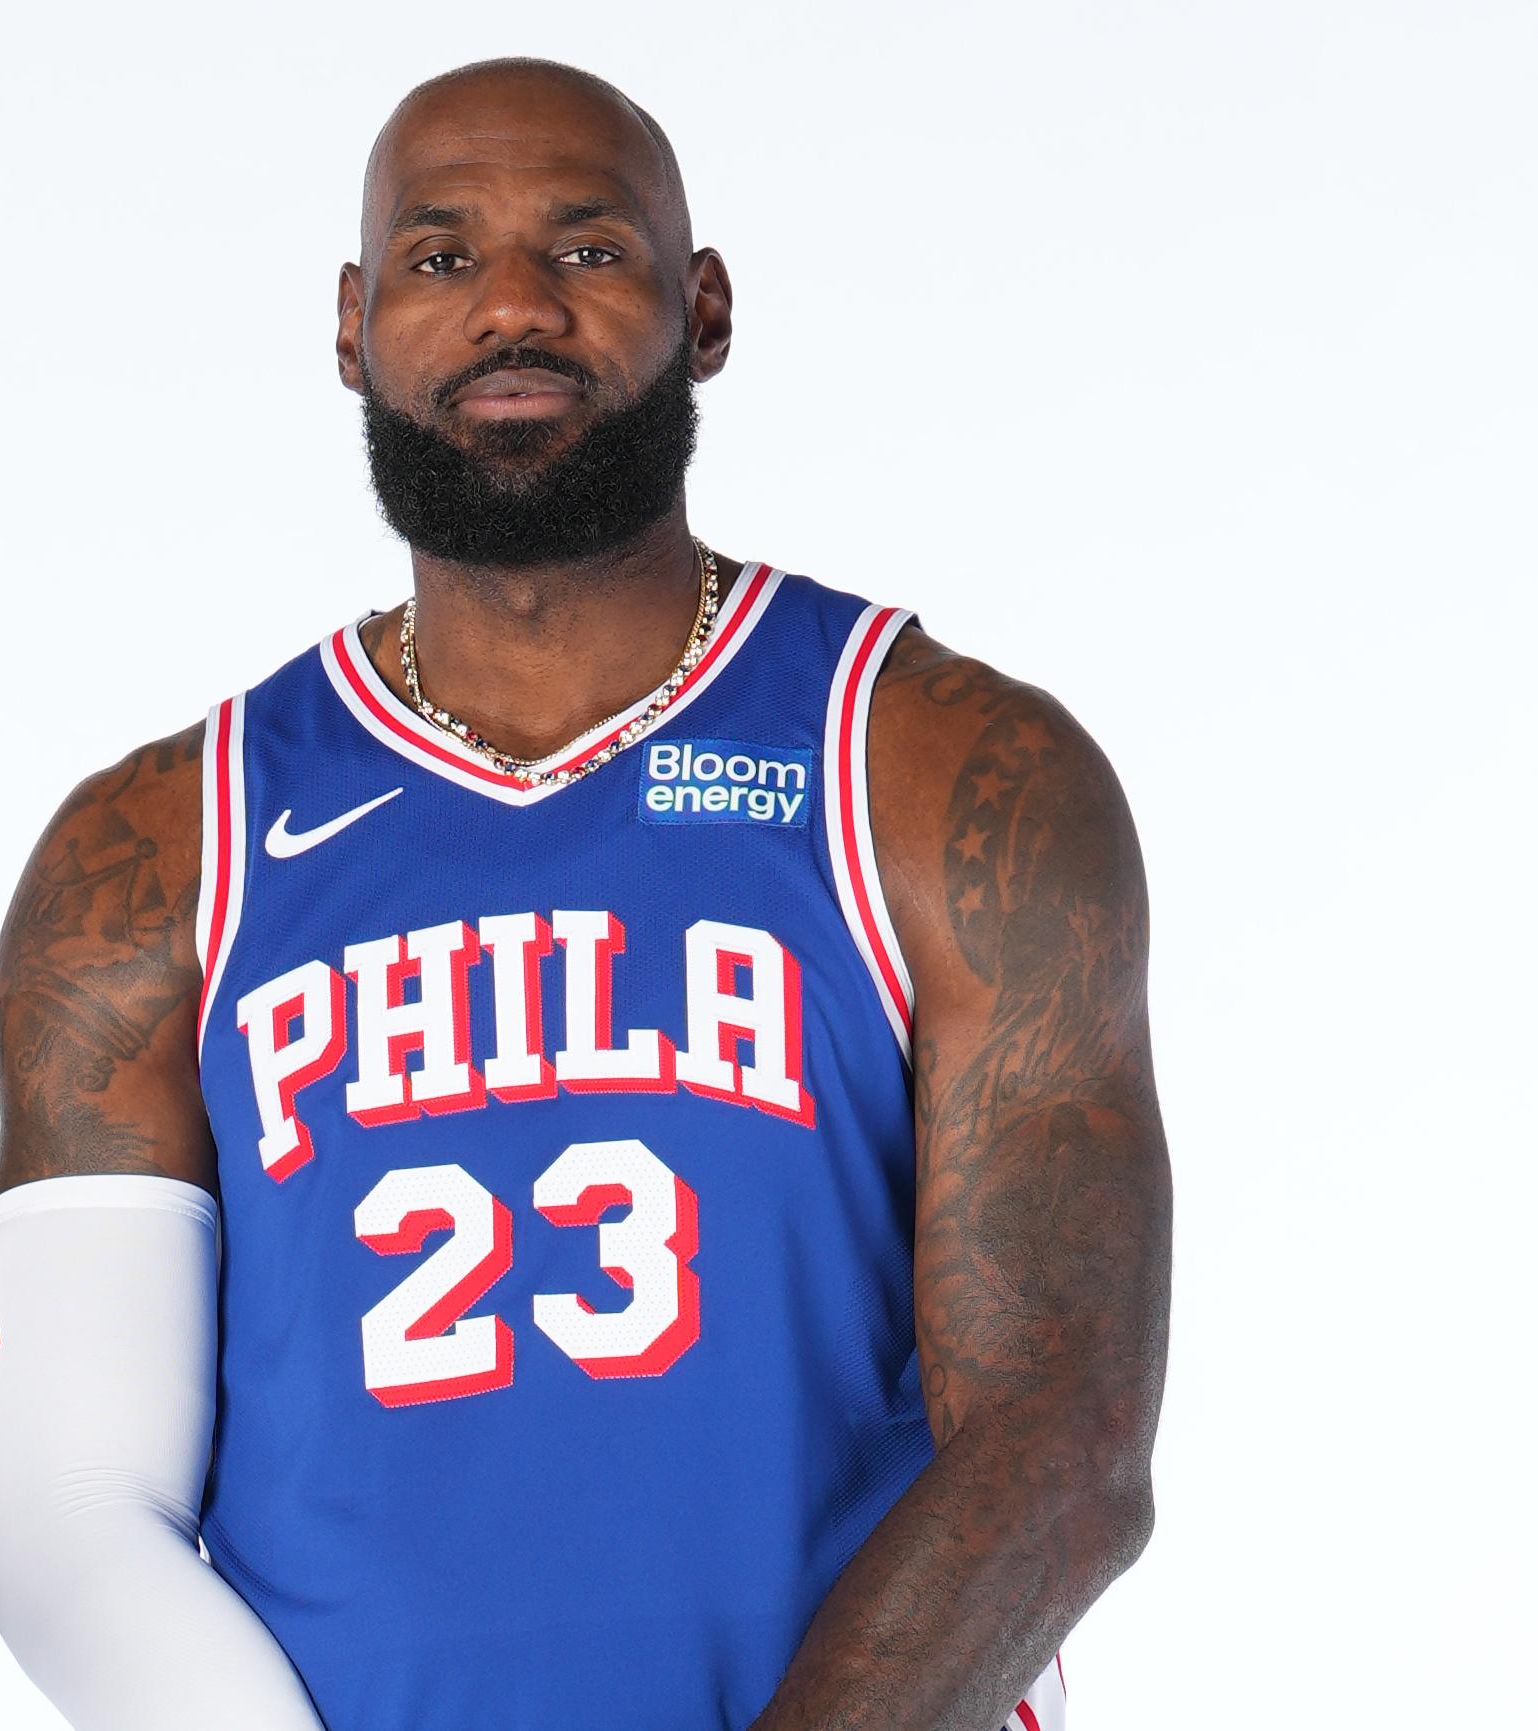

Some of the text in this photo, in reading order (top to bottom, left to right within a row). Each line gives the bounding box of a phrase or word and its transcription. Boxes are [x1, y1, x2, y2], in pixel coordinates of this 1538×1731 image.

[646, 785, 805, 824] energy
[648, 744, 806, 789] Bloom
[237, 910, 816, 1183] PHILA
[354, 1139, 701, 1409] 23
